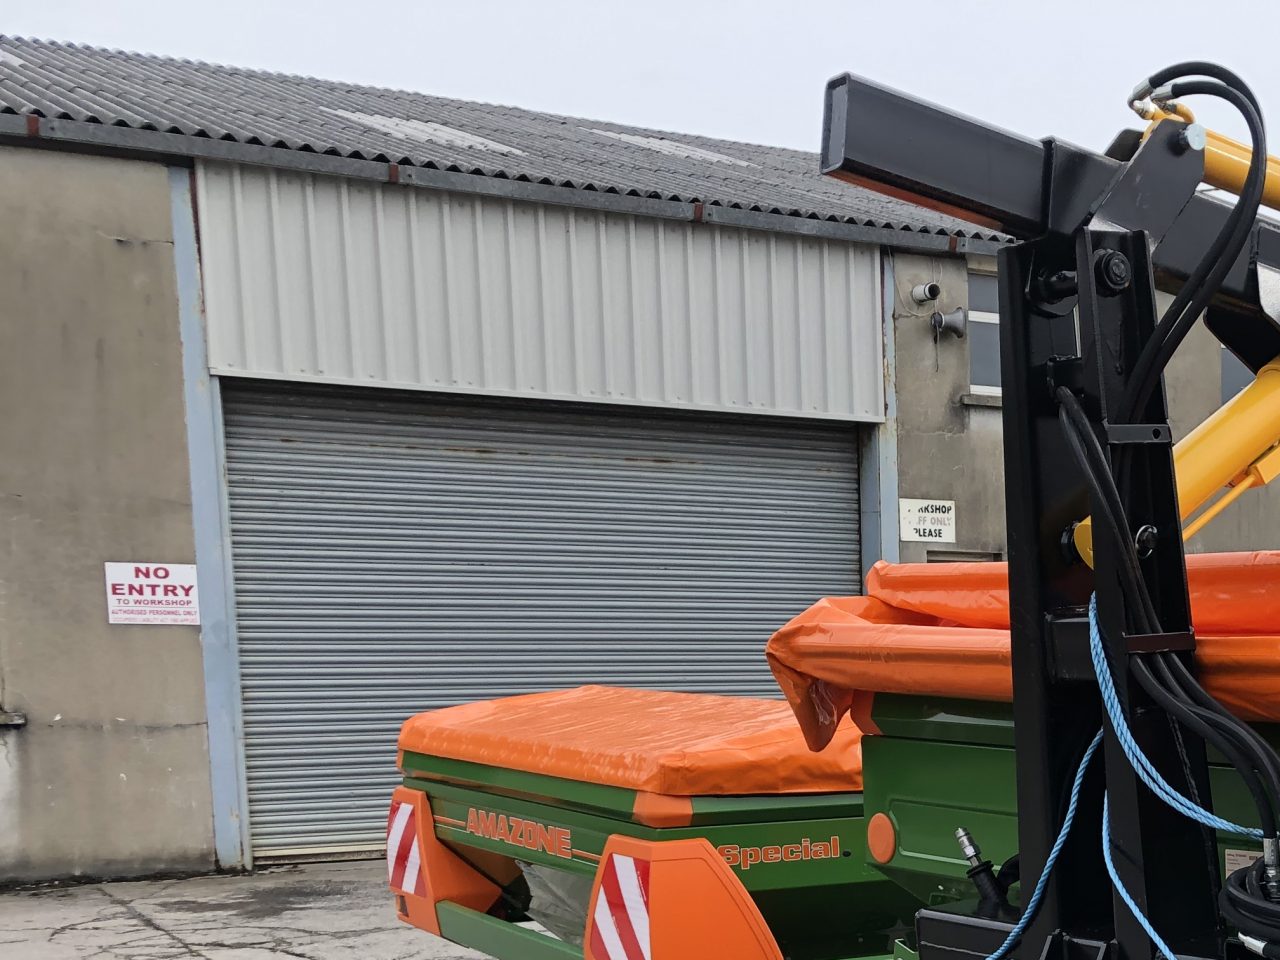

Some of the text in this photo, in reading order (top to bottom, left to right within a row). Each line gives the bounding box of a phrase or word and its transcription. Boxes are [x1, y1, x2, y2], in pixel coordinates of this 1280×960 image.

[134, 566, 170, 579] NO
[111, 583, 194, 597] ENTRY
[467, 808, 572, 859] AMAZONE
[717, 836, 840, 870] Special
